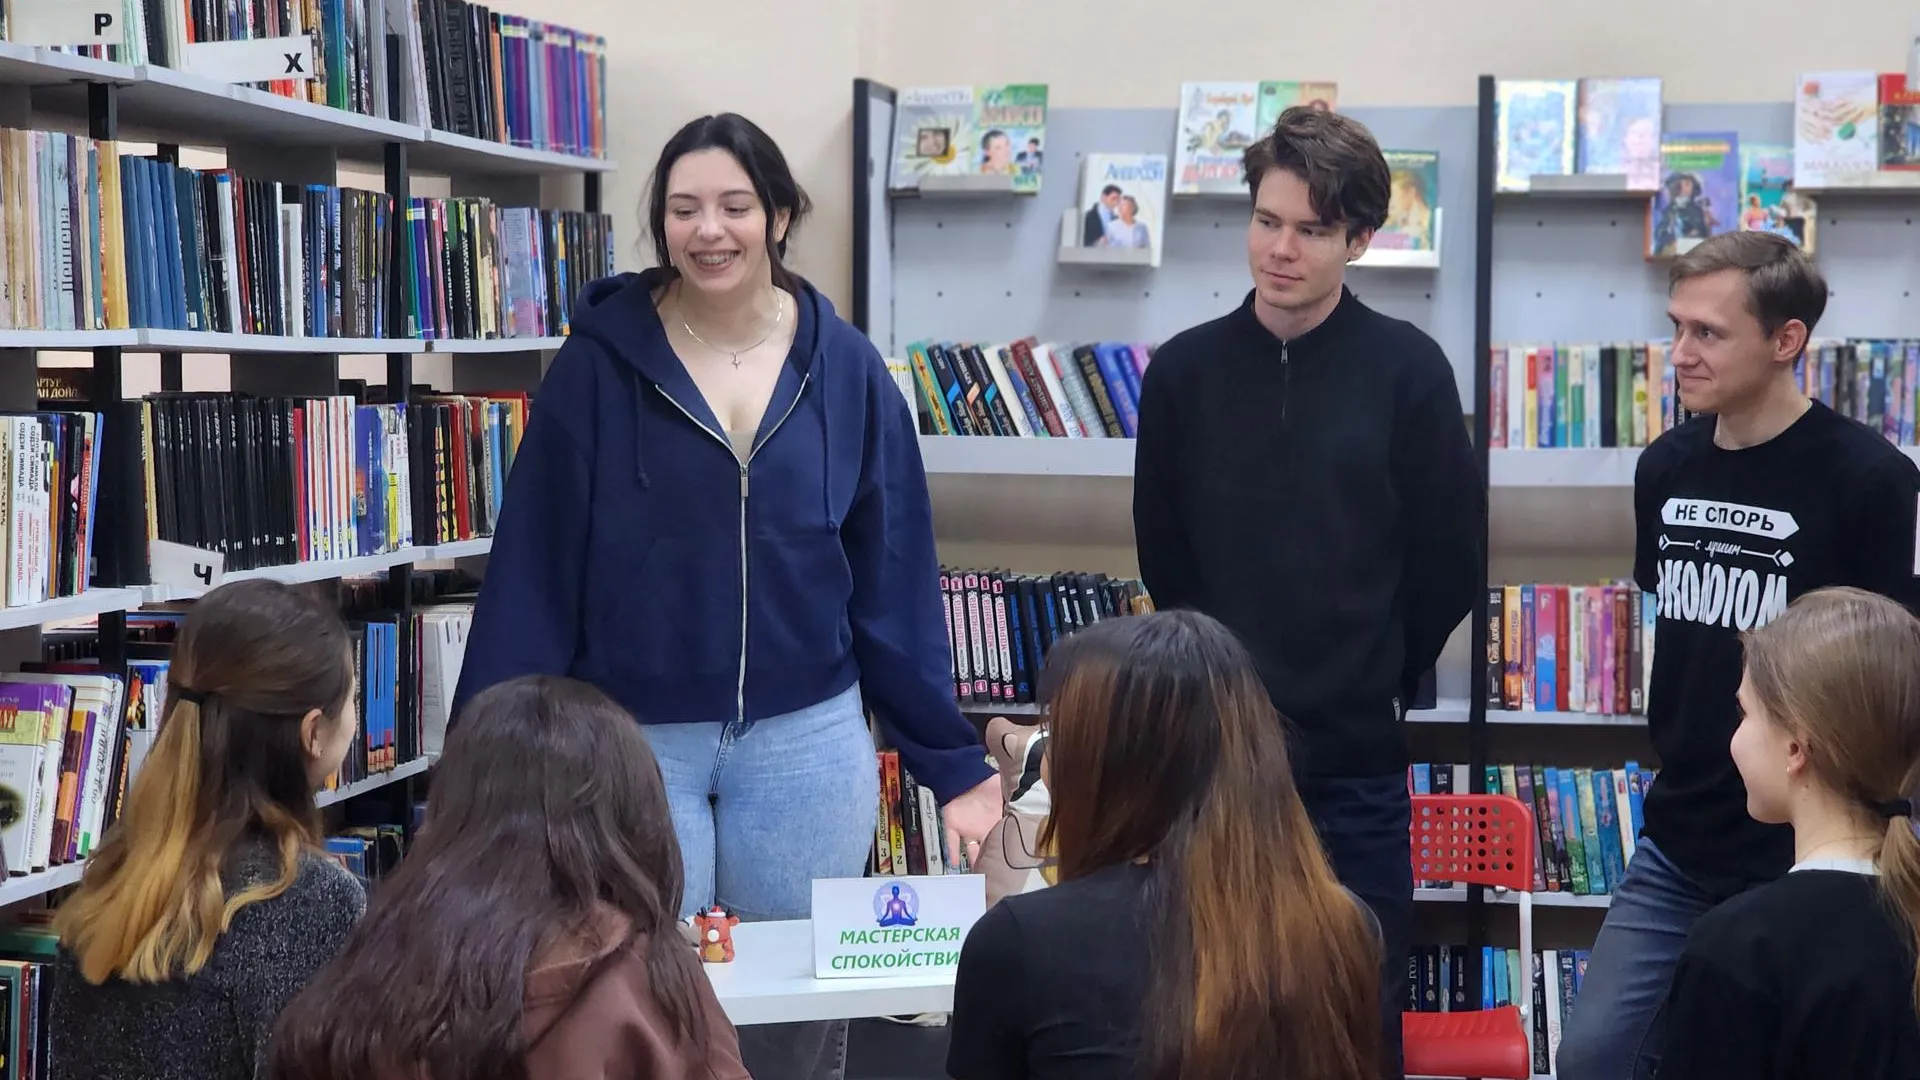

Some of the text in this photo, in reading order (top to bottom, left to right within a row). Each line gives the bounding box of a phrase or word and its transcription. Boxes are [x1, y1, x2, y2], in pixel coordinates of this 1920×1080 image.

[94, 13, 113, 36] Р
[284, 52, 305, 74] Х
[36, 377, 62, 388] РТУР
[36, 387, 49, 399] АН
[1675, 503, 1775, 532] НЕ СПОРЬ
[192, 562, 214, 587] Ч
[896, 855, 903, 866] 2
[839, 926, 961, 945] МАСТЕРСКАЯ
[831, 948, 959, 969] СПОКОЙСТВИ
